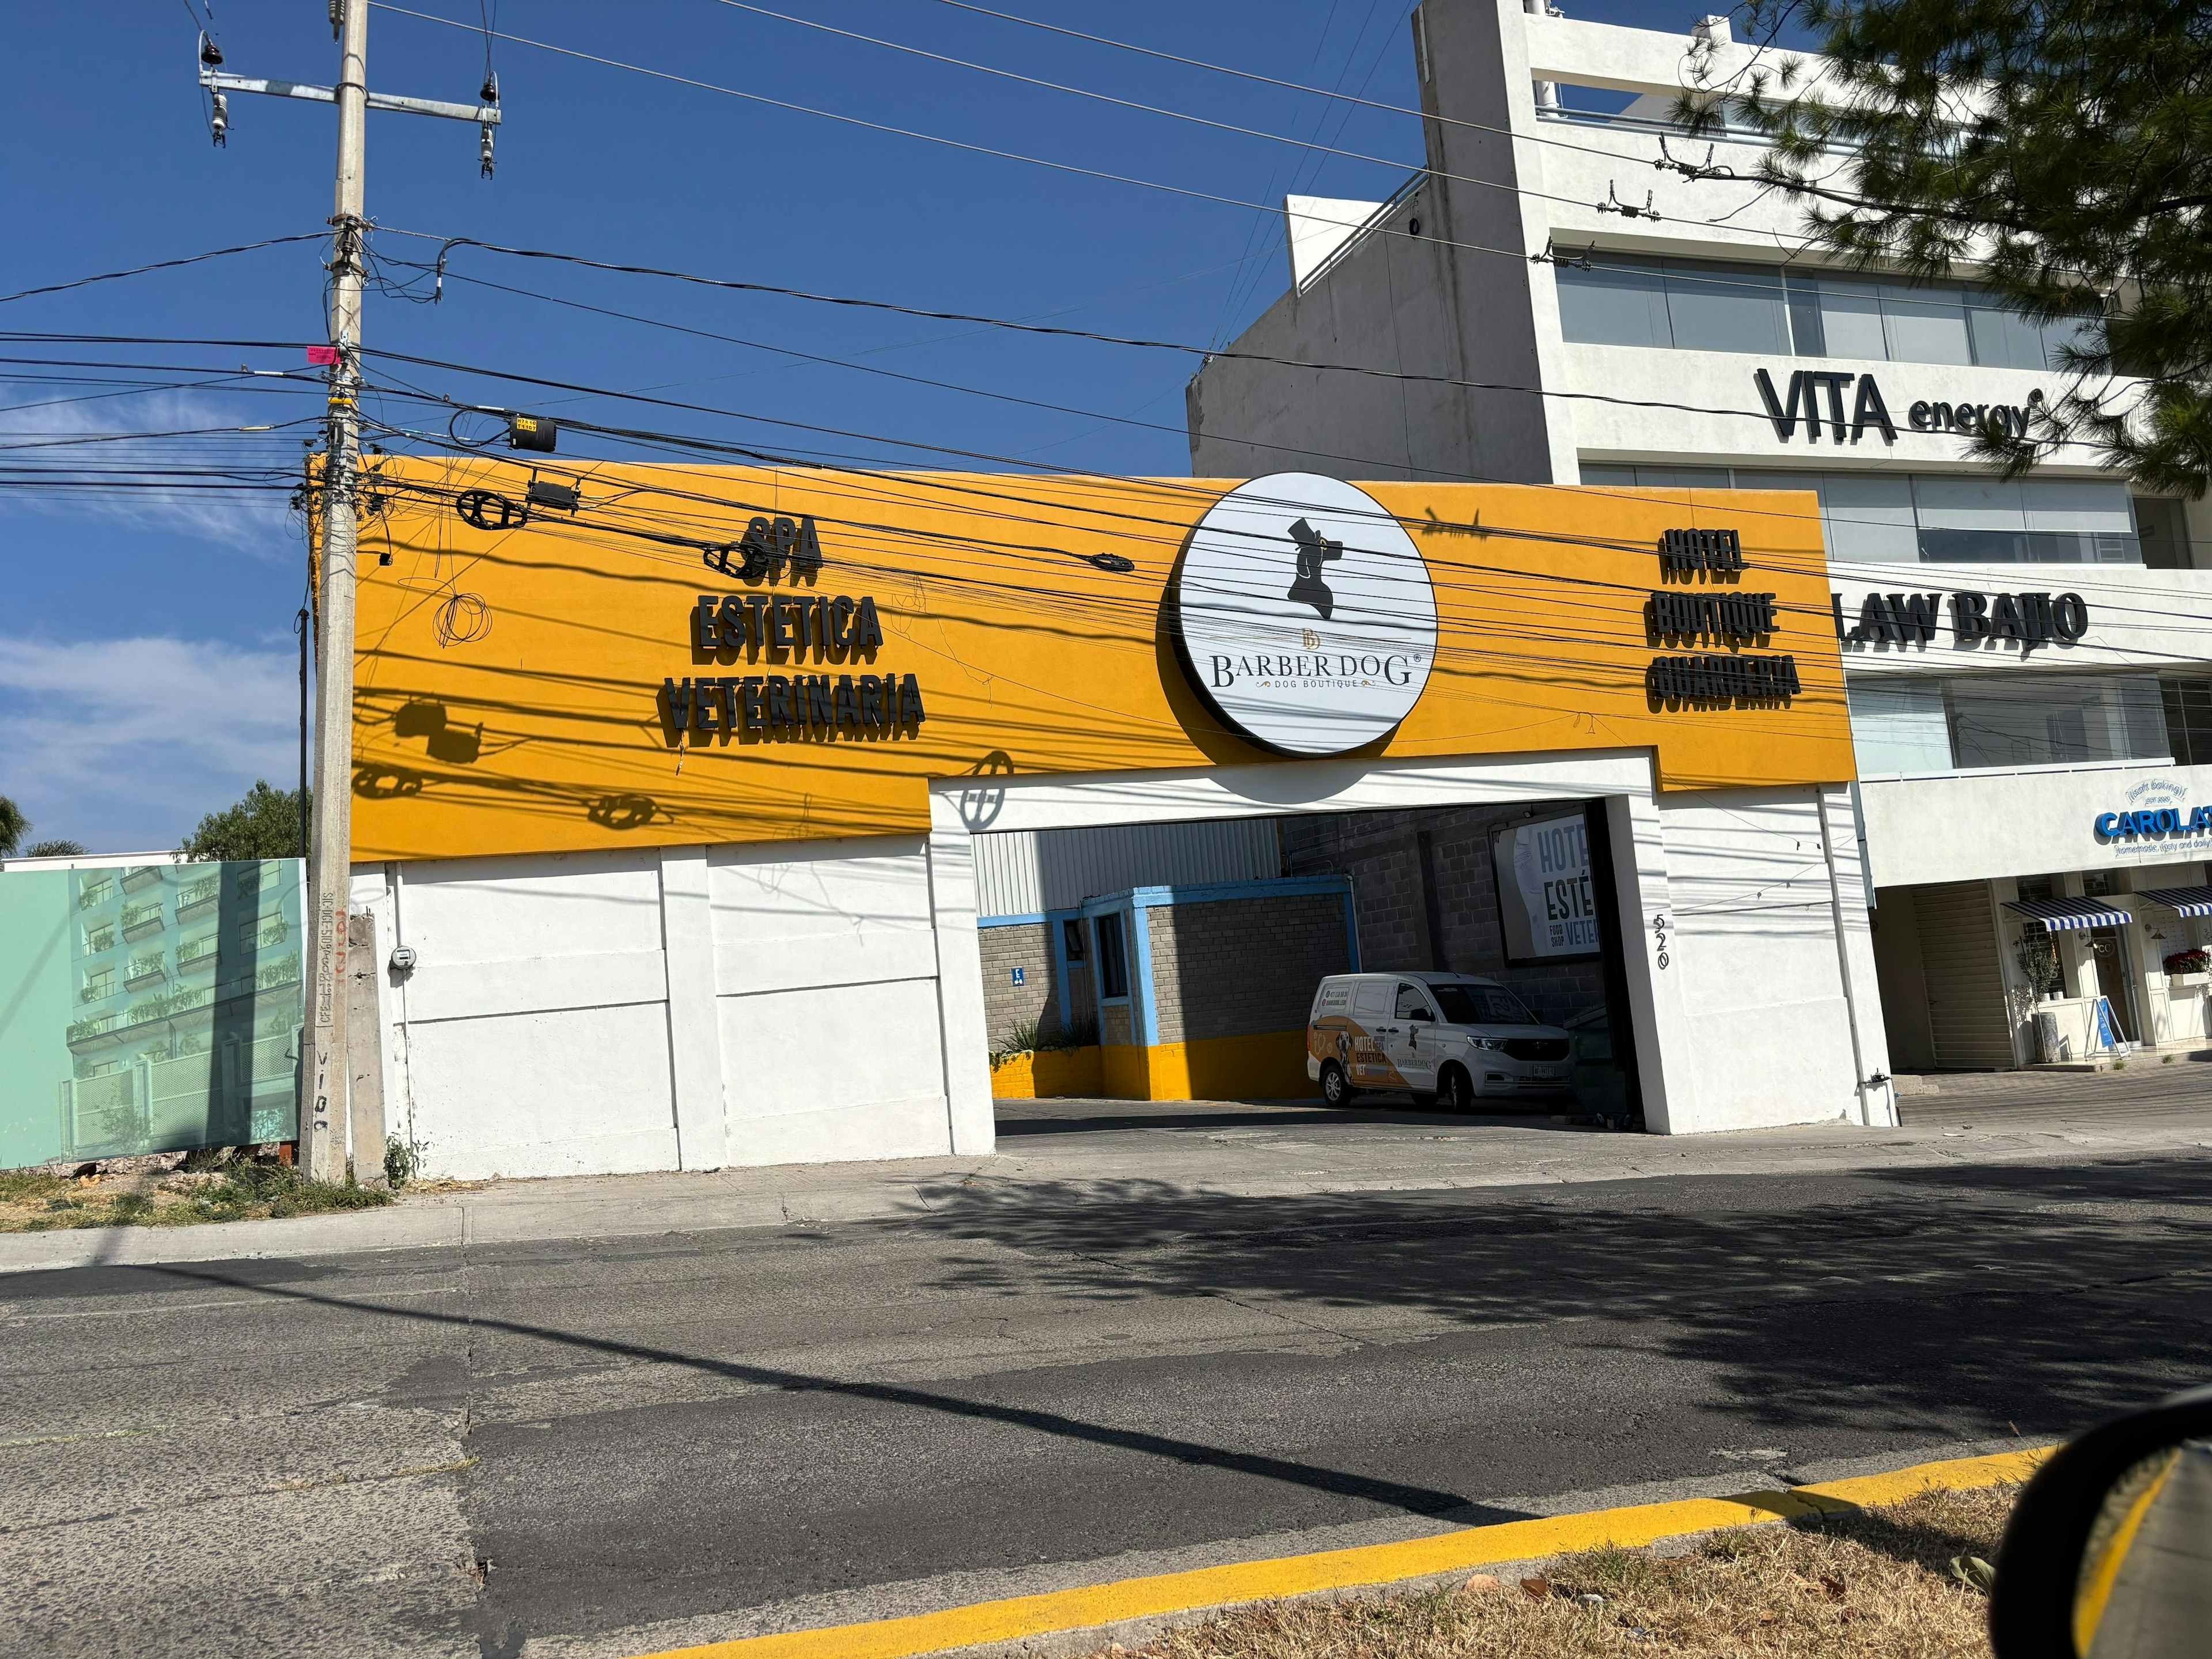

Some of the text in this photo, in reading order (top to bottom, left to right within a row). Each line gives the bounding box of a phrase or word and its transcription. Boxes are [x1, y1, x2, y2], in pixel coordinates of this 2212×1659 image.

[1756, 368, 1898, 441] VITA
[747, 516, 824, 569] SPA
[1663, 528, 1750, 570] HOTEL
[698, 595, 883, 647] ESTETICA
[1650, 591, 1781, 640] BOUTIQUE
[1831, 592, 2089, 652] LAW BAJIO
[1303, 680, 1357, 688] BOUTIQUE
[1651, 654, 1801, 698] GUARDERIA
[664, 673, 927, 730] VETERINARIA
[2179, 840, 2192, 849] and
[1549, 925, 1563, 935] FOOD
[1551, 936, 1565, 947] SHOP
[1653, 914, 1669, 971] 520
[1015, 968, 1020, 978] E
[1354, 1036, 1375, 1051] HOTEL
[1356, 1052, 1387, 1063] ESTETICA
[1355, 1064, 1365, 1075] VET
